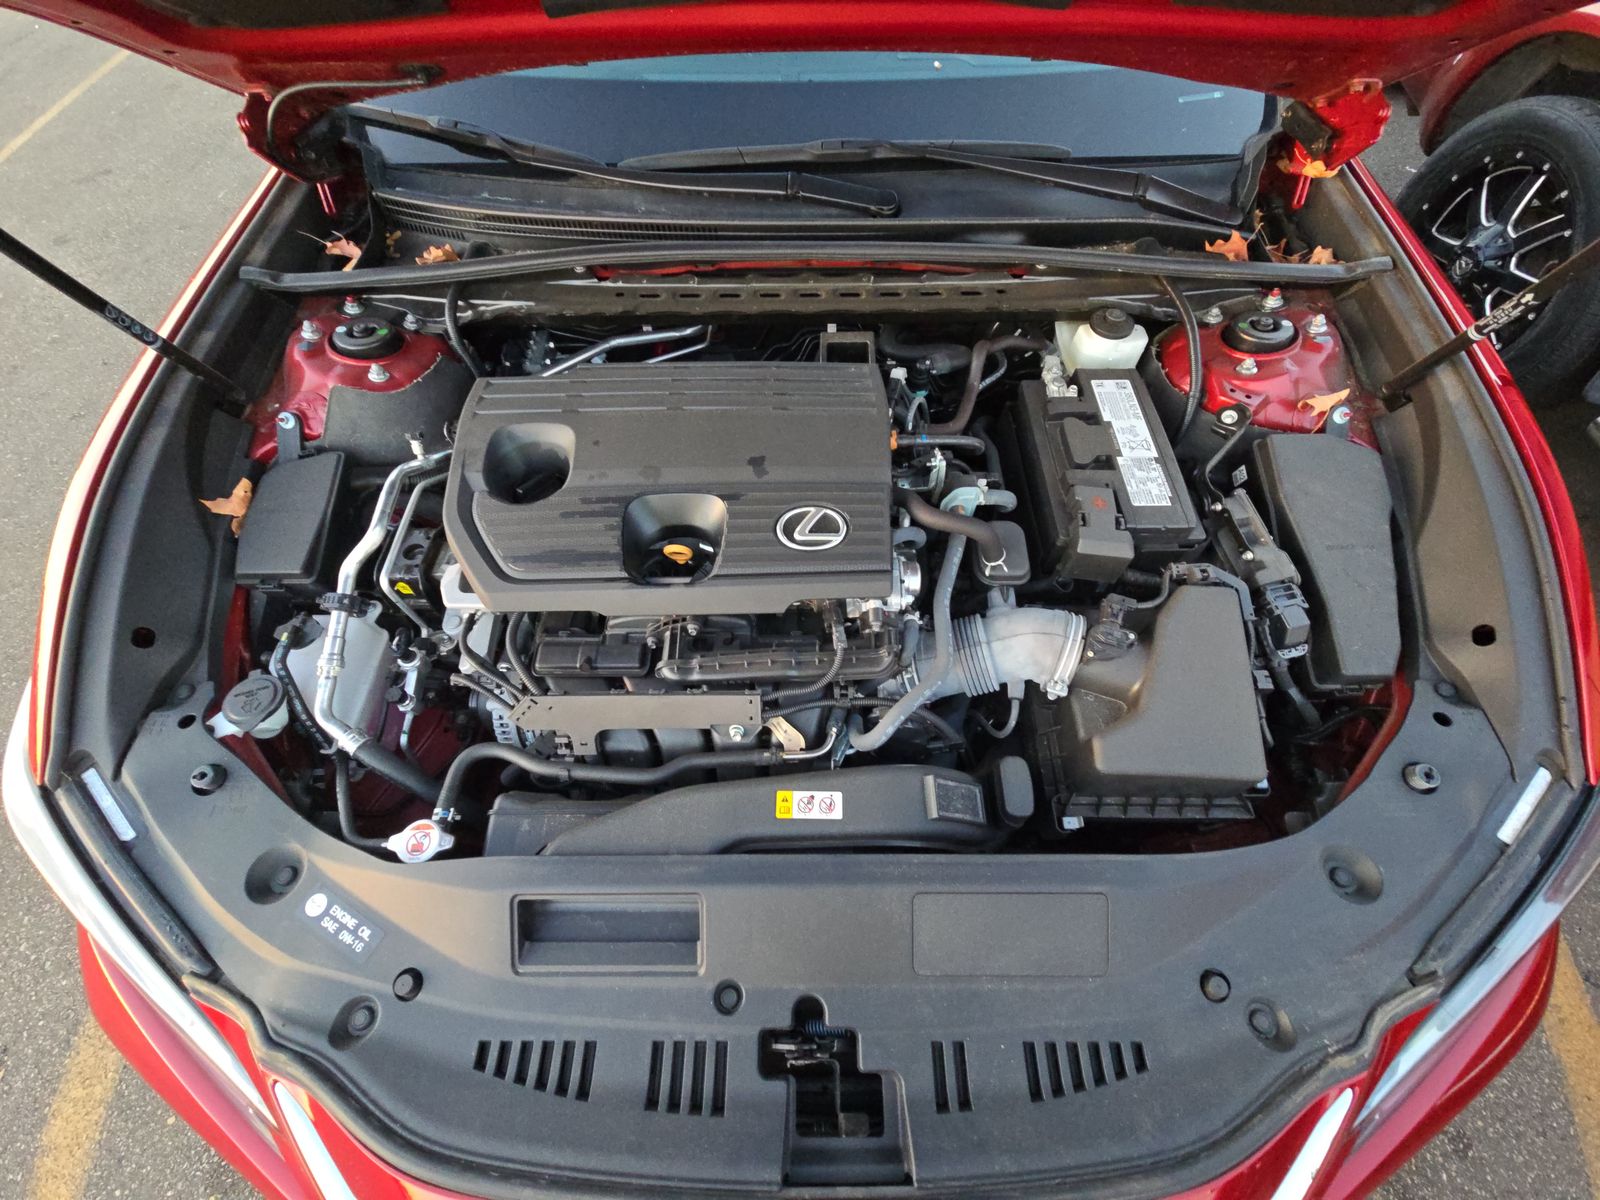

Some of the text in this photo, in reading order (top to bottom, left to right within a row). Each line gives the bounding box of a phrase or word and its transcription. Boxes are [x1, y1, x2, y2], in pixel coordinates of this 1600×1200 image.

[320, 916, 364, 952] SAE 0W-16
[329, 905, 371, 941] ENGINE OIL
